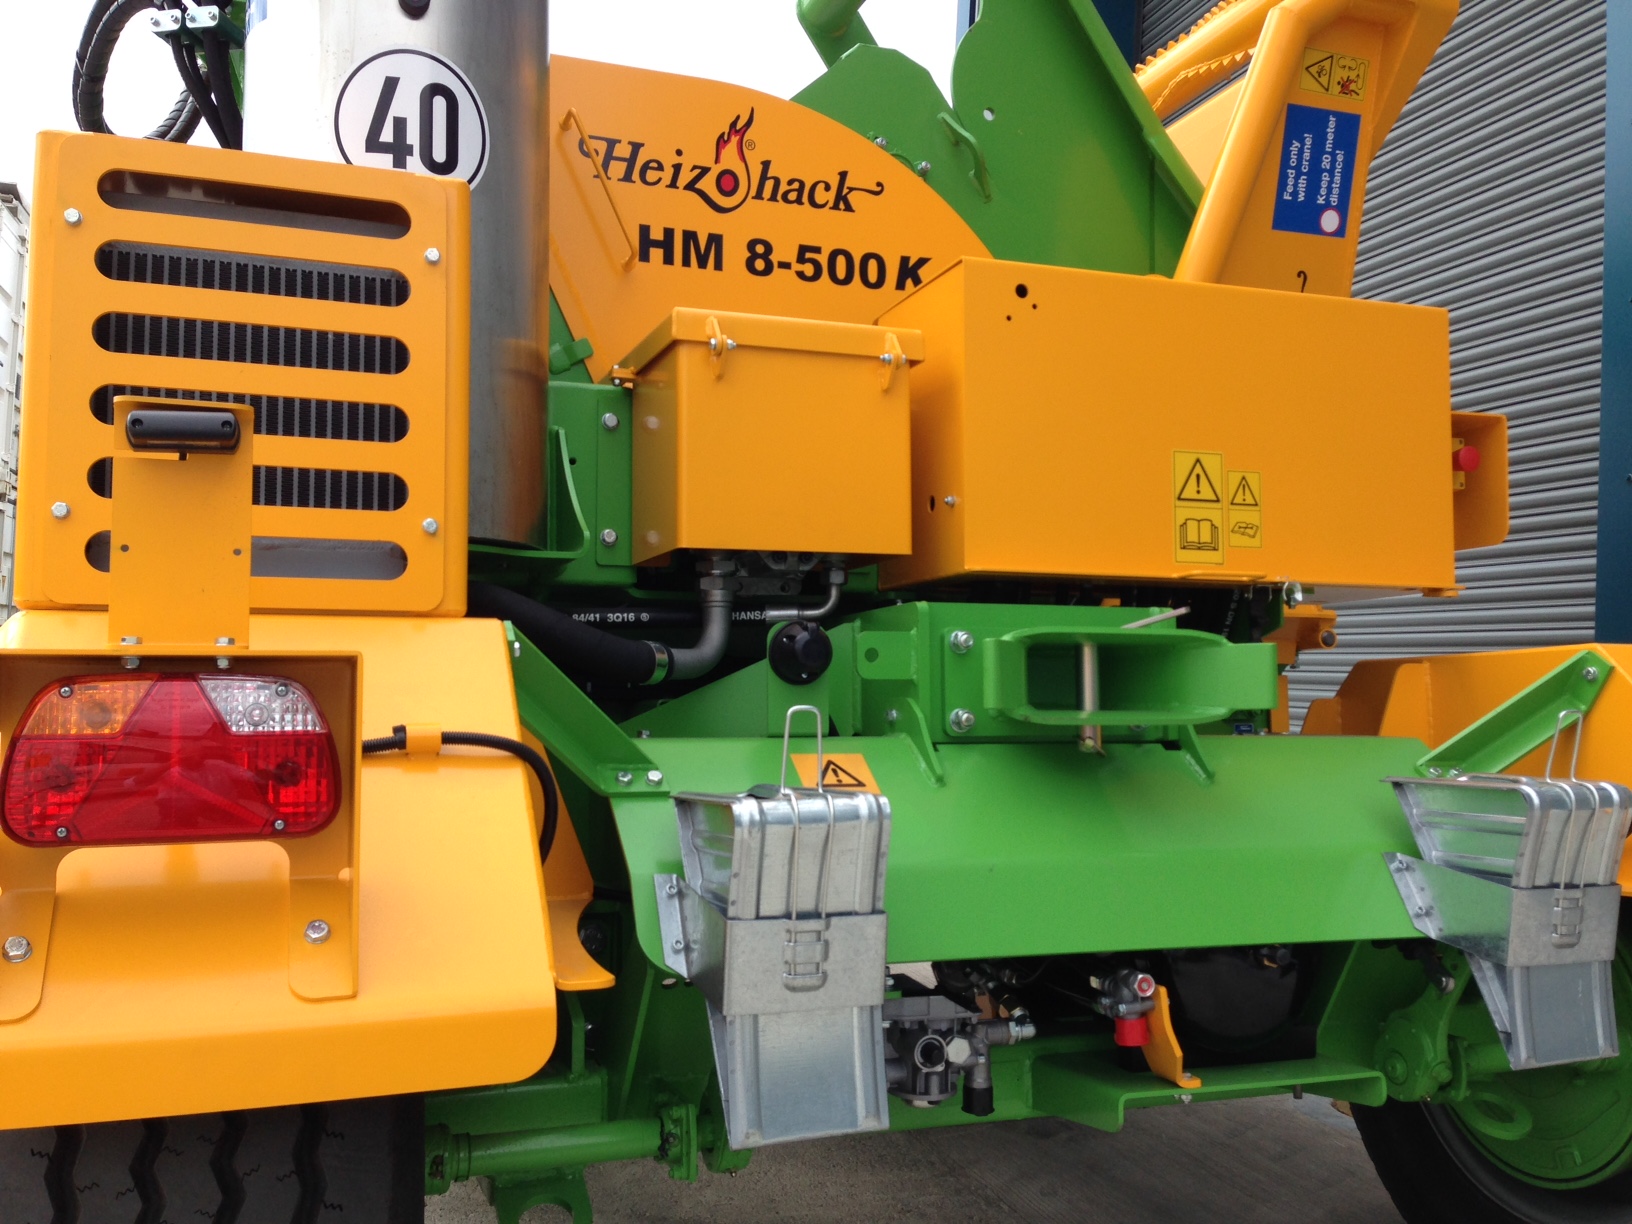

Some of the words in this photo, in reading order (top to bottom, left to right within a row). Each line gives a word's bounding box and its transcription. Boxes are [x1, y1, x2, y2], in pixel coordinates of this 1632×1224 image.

[365, 75, 459, 176] 40
[1325, 114, 1336, 152] meter
[1289, 139, 1301, 167] only
[1301, 133, 1313, 173] crane!
[1321, 154, 1331, 170] 20
[1283, 169, 1296, 200] Feed
[1297, 175, 1308, 202] with
[1316, 172, 1330, 204] Keep
[1329, 149, 1345, 206] distance!
[638, 223, 724, 271] HM
